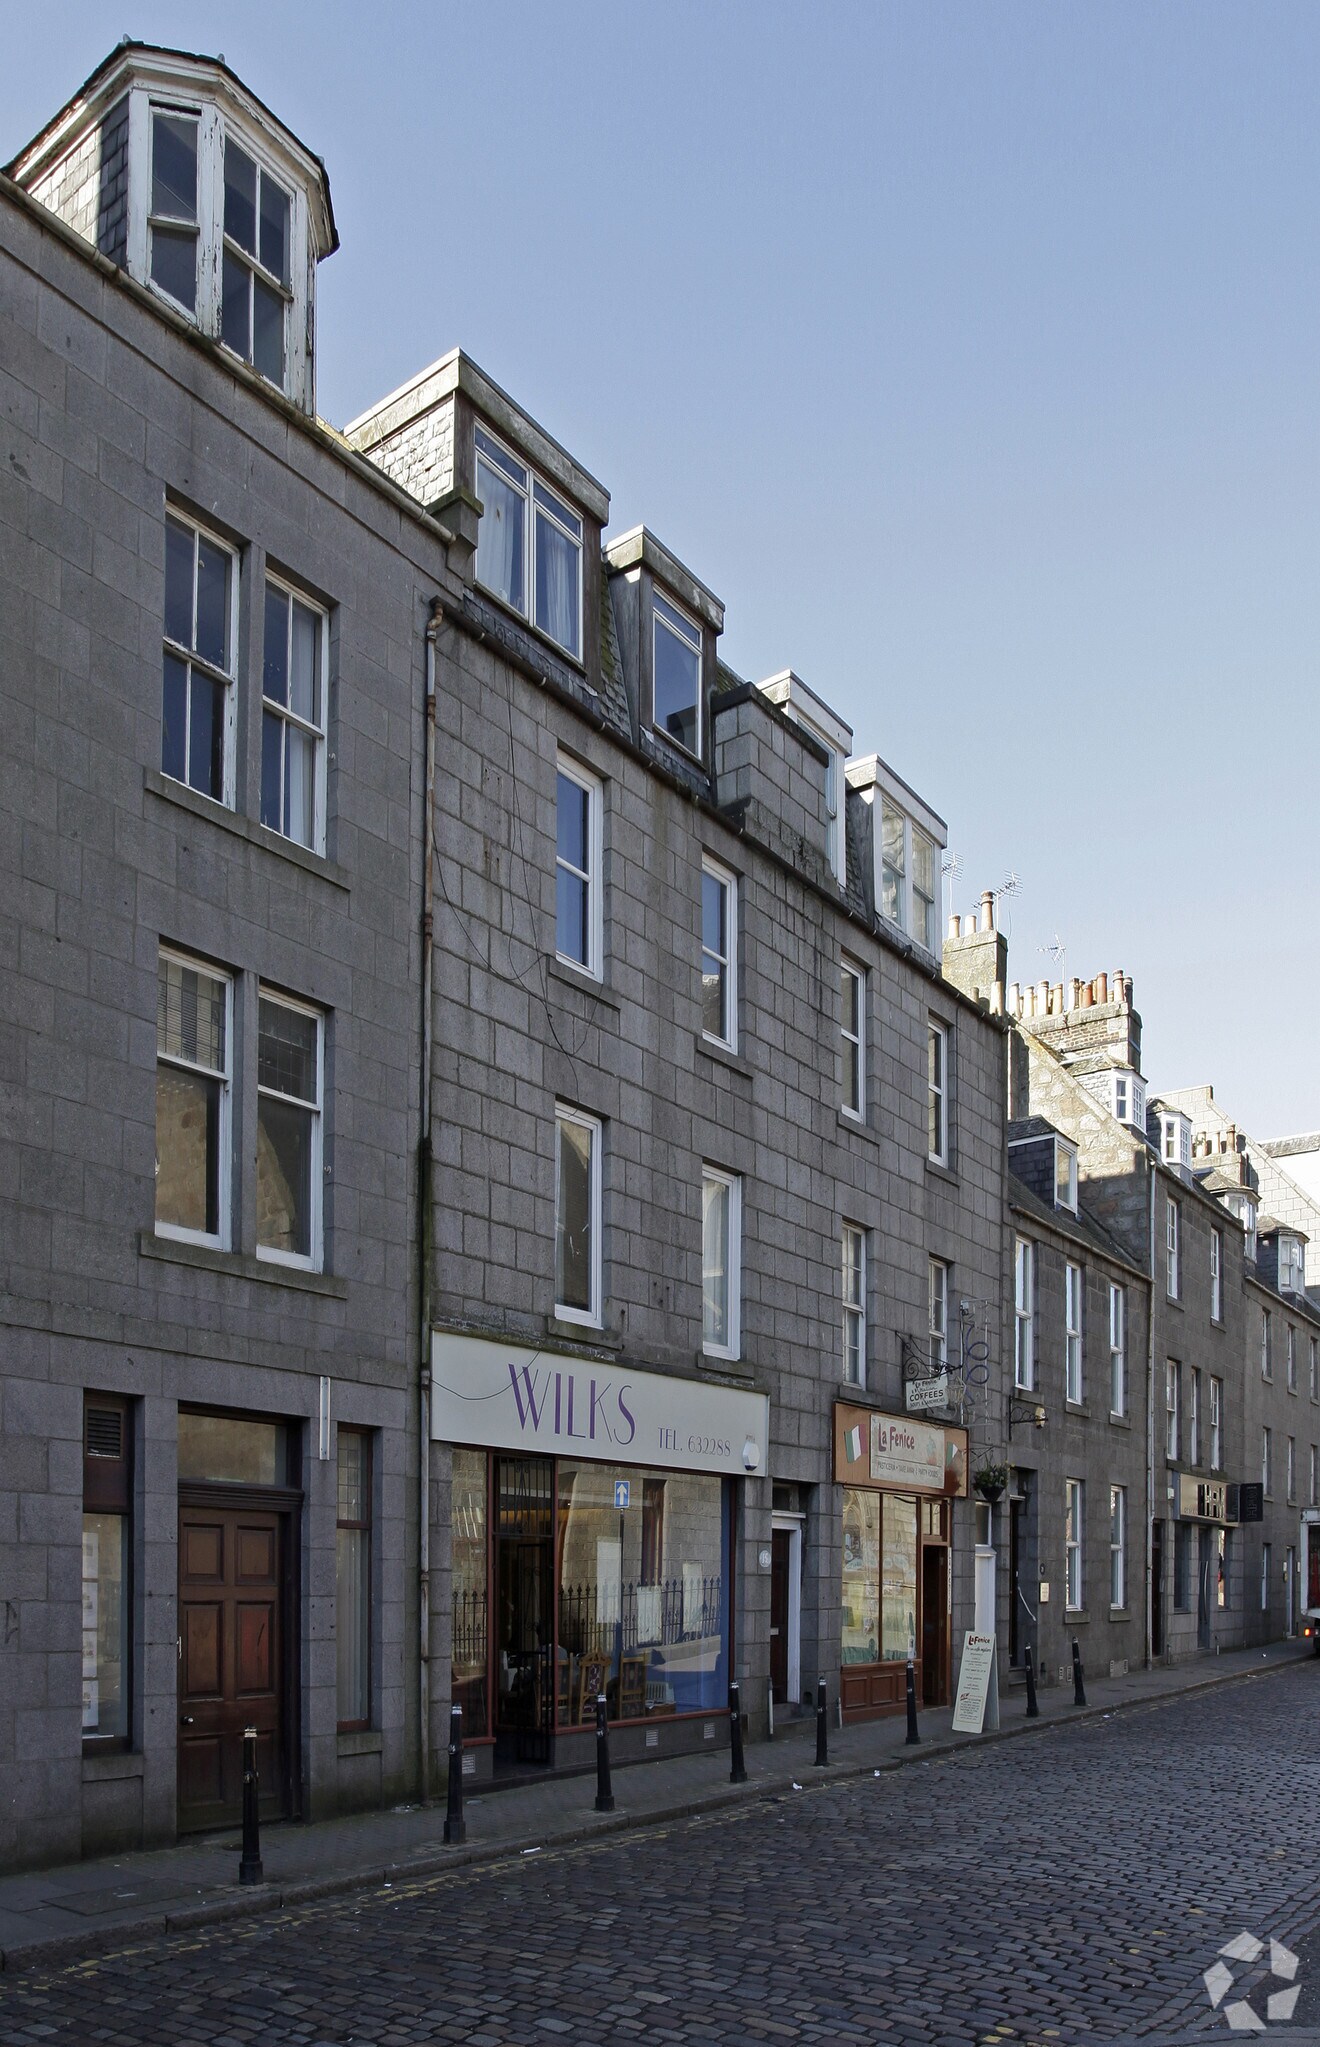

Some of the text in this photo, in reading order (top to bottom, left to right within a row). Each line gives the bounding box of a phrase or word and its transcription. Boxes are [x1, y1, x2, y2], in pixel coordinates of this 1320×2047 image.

[508, 1363, 636, 1445] WILKS
[909, 1389, 944, 1402] COFFEES
[687, 1435, 731, 1457] 632288
[878, 1422, 915, 1452] La Fenice
[968, 1634, 991, 1646] La Fenice
